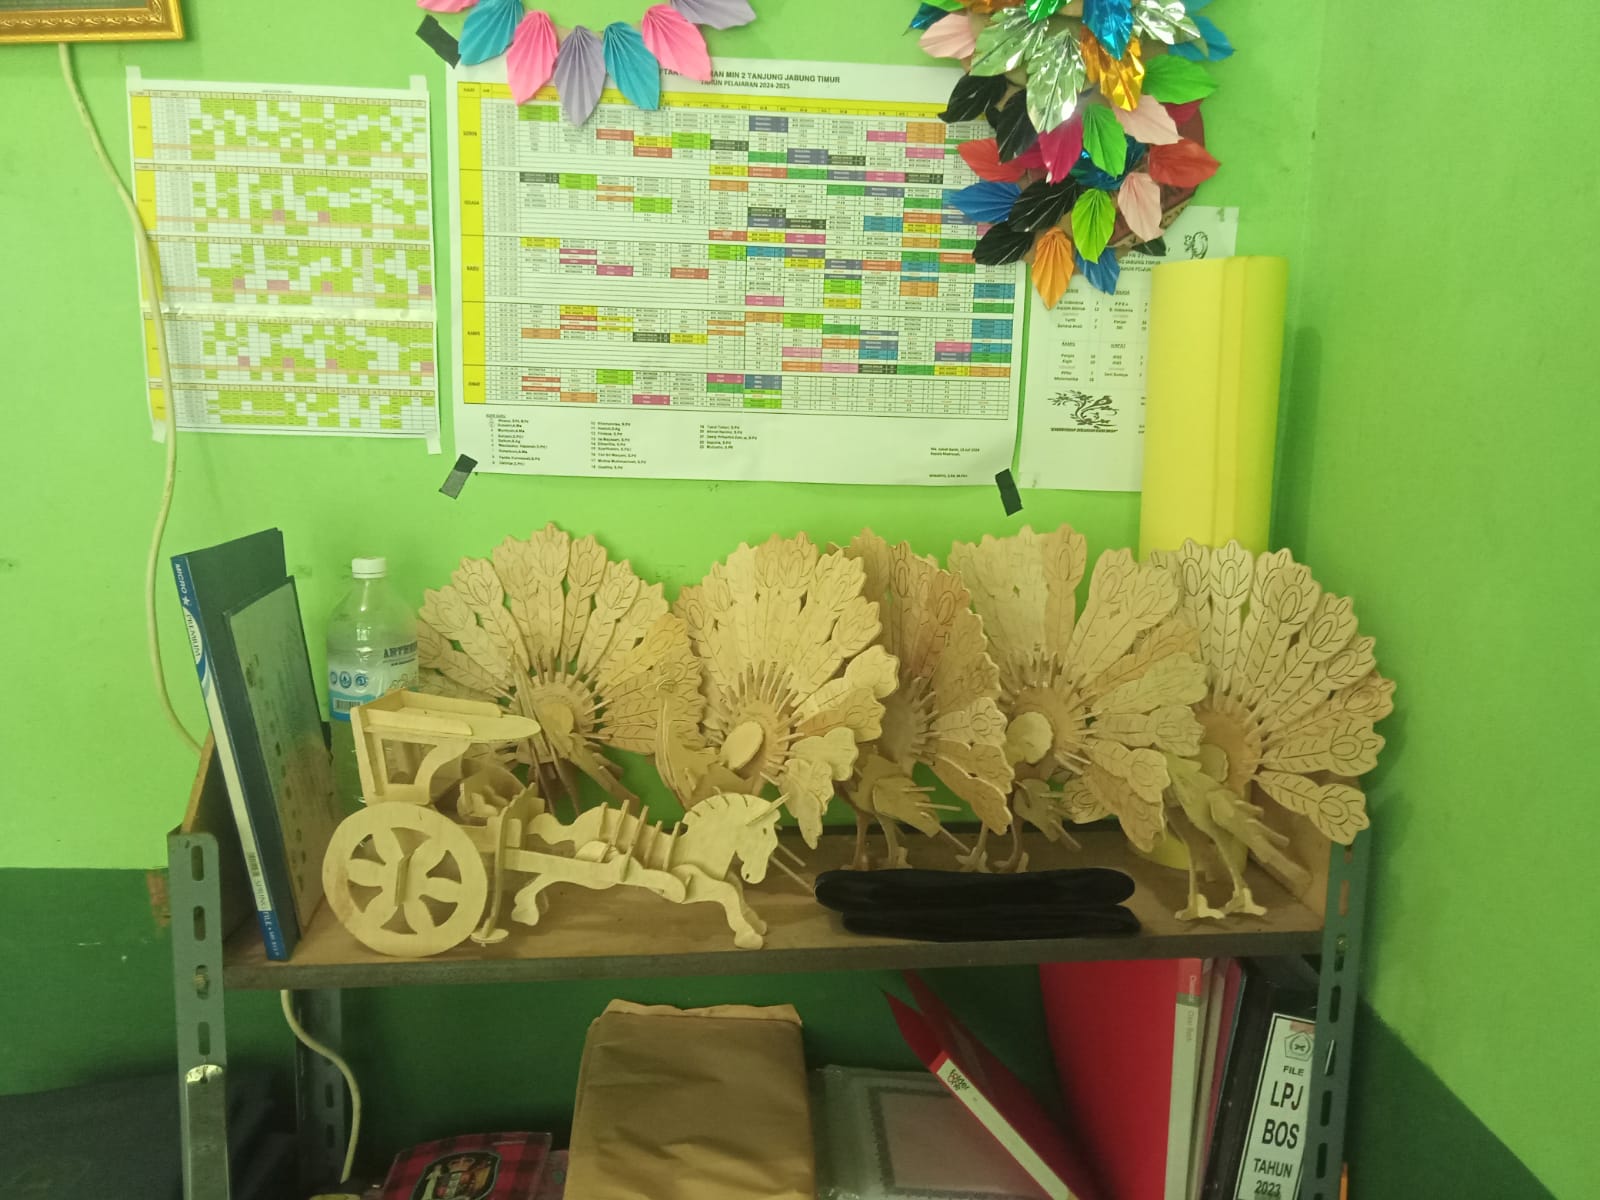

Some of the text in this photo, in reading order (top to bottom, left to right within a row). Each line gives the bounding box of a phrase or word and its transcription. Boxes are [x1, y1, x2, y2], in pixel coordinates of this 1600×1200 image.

[726, 71, 740, 79] MIN
[747, 73, 784, 81] TANJUNG
[817, 75, 841, 84] TIMUR
[175, 563, 188, 594] MICRO
[186, 613, 201, 656] PREMIUM
[1283, 1064, 1305, 1077] FILE
[1270, 1080, 1304, 1111] LPJ
[1261, 1118, 1300, 1150] BOS
[1253, 1157, 1294, 1179] TAHUN
[1254, 1180, 1282, 1198] 2023
